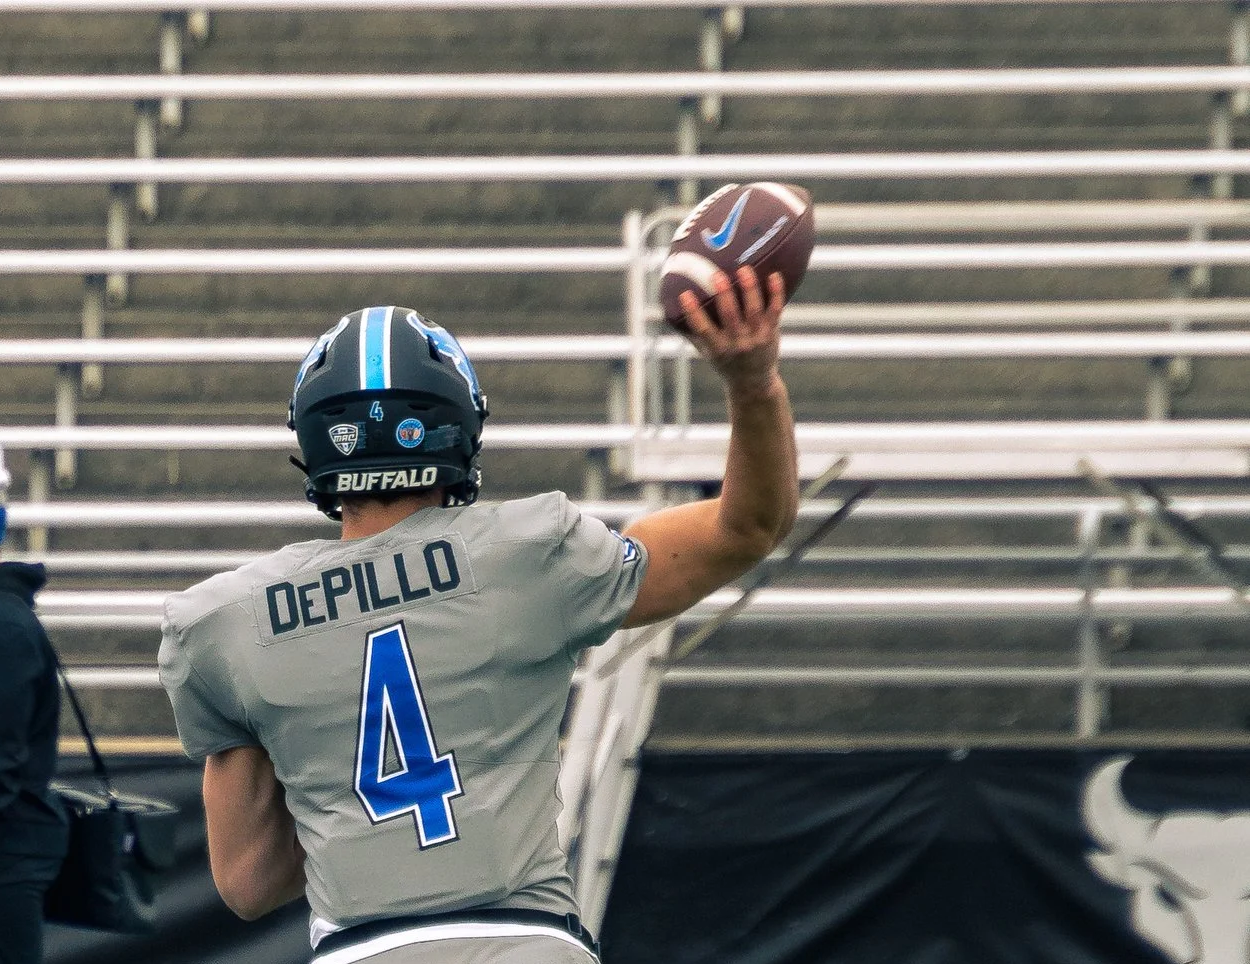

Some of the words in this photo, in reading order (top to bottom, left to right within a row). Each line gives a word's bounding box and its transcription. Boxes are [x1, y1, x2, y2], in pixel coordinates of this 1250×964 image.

[369, 400, 384, 422] 4
[333, 434, 356, 443] MAC
[336, 466, 439, 493] BUFFALO
[353, 620, 463, 850] 4
